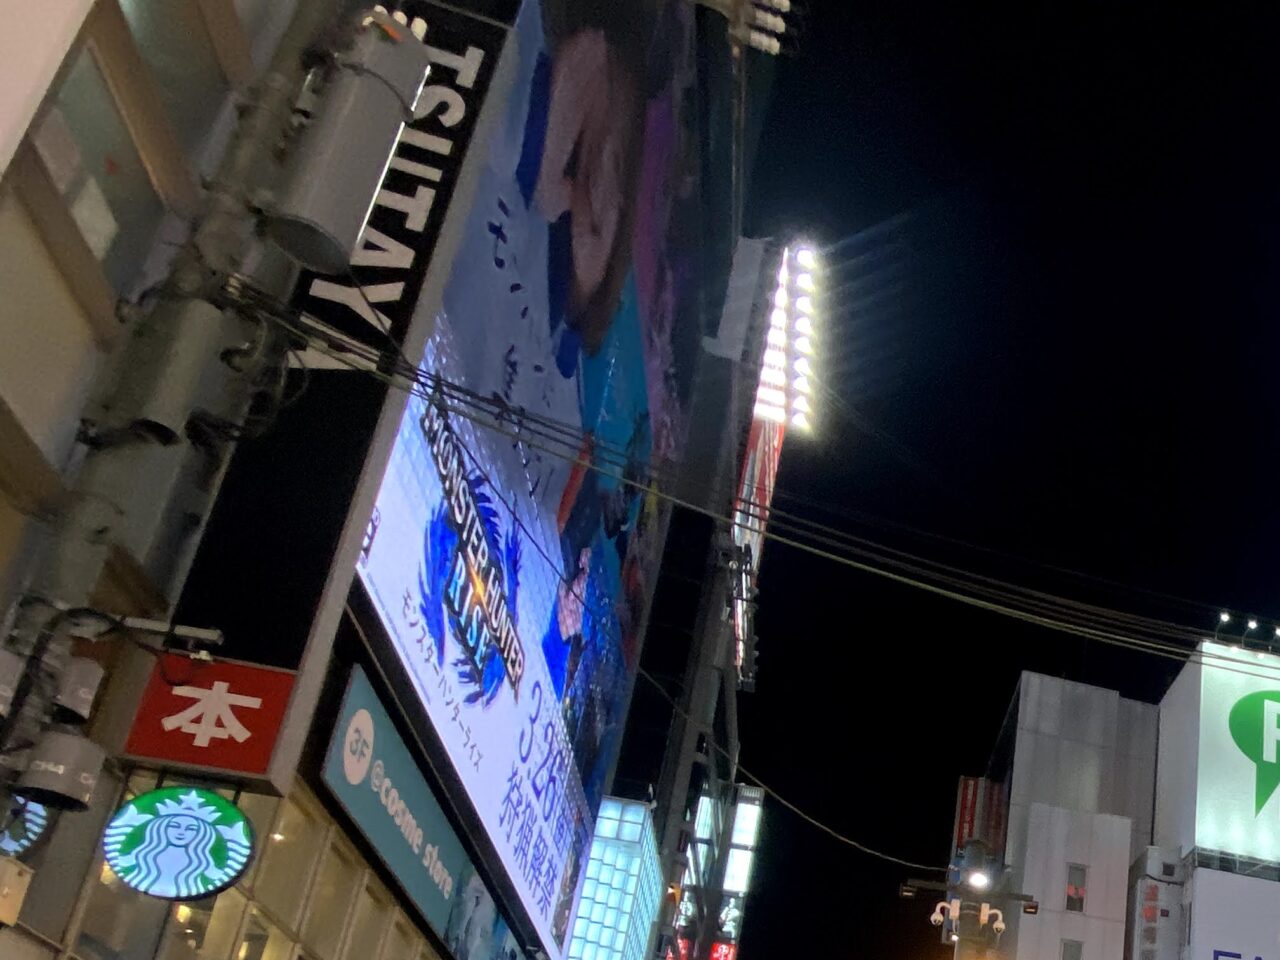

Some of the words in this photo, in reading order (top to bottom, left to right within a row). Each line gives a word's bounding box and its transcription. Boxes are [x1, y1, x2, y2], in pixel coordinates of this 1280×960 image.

[424, 404, 491, 573] MONSTER
[482, 566, 524, 684] HUNTER
[448, 552, 491, 670] RISE
[161, 680, 262, 748] 本
[371, 759, 424, 855] @cosme
[422, 842, 454, 900] store
